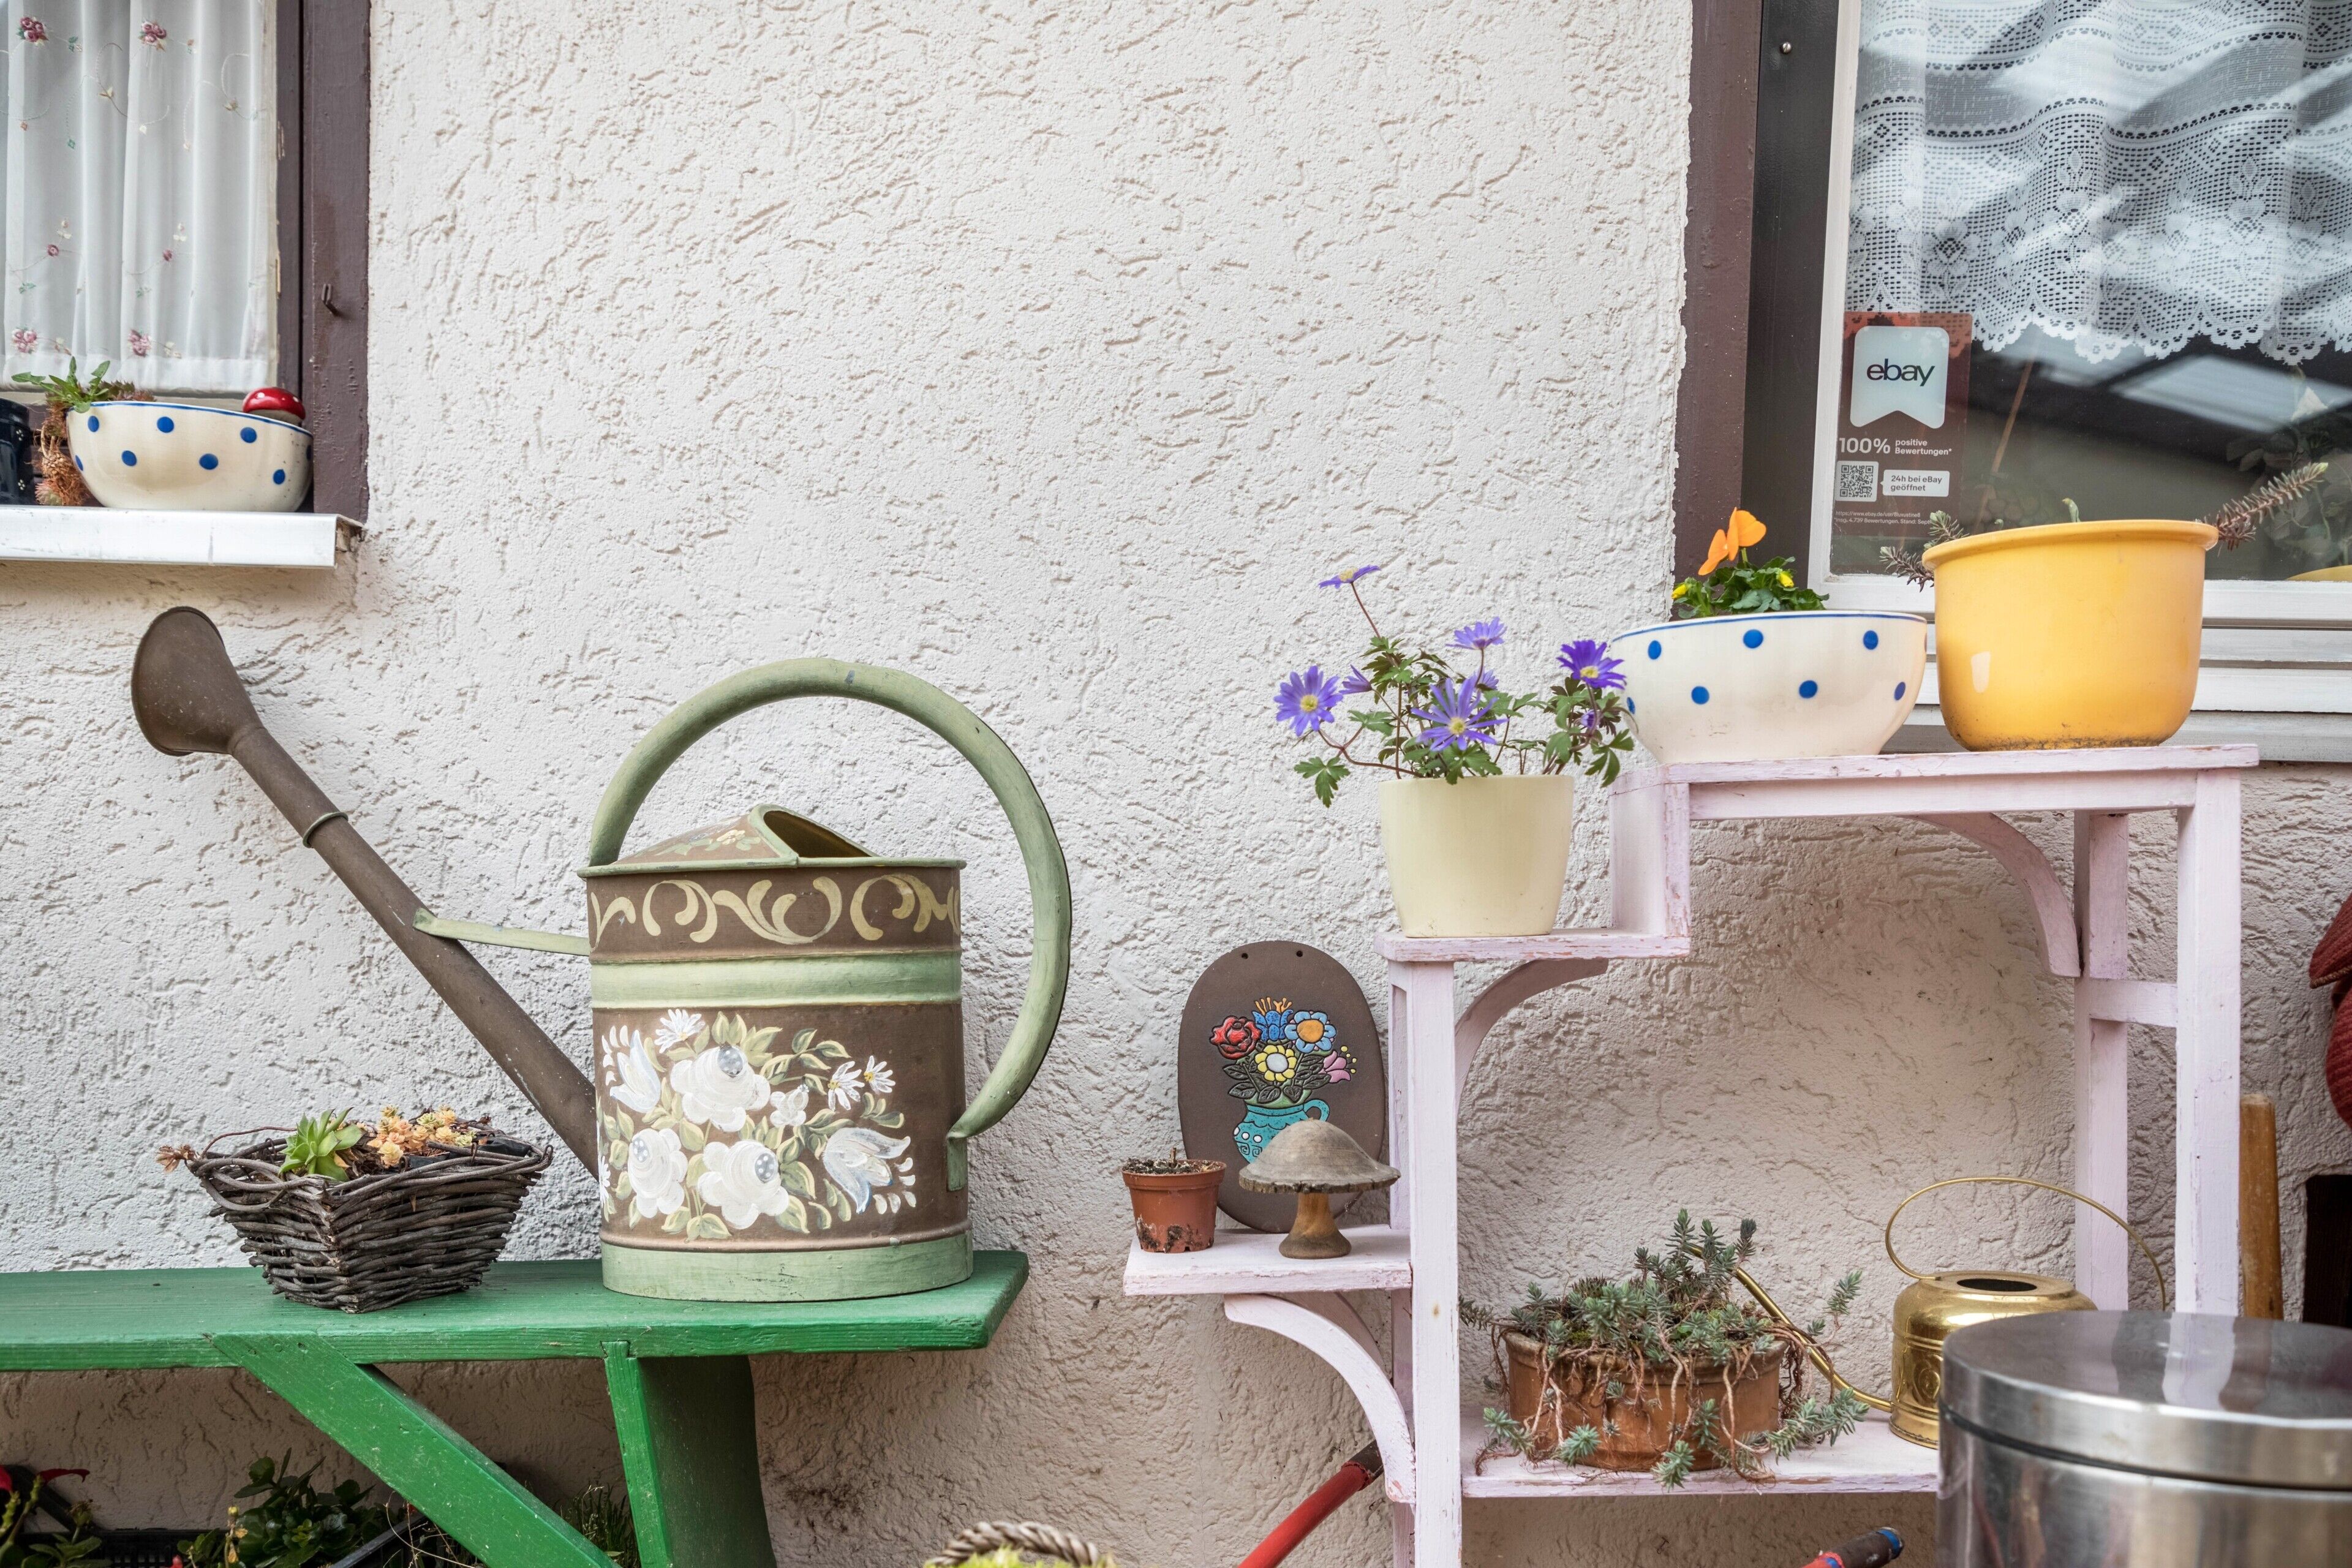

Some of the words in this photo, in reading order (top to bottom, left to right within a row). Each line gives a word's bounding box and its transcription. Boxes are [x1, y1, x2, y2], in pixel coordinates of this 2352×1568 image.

[1866, 358, 1936, 387] ebay
[1839, 437, 1891, 454] 100%
[1895, 439, 1928, 447] positive
[1890, 483, 1926, 492] geöffnet
